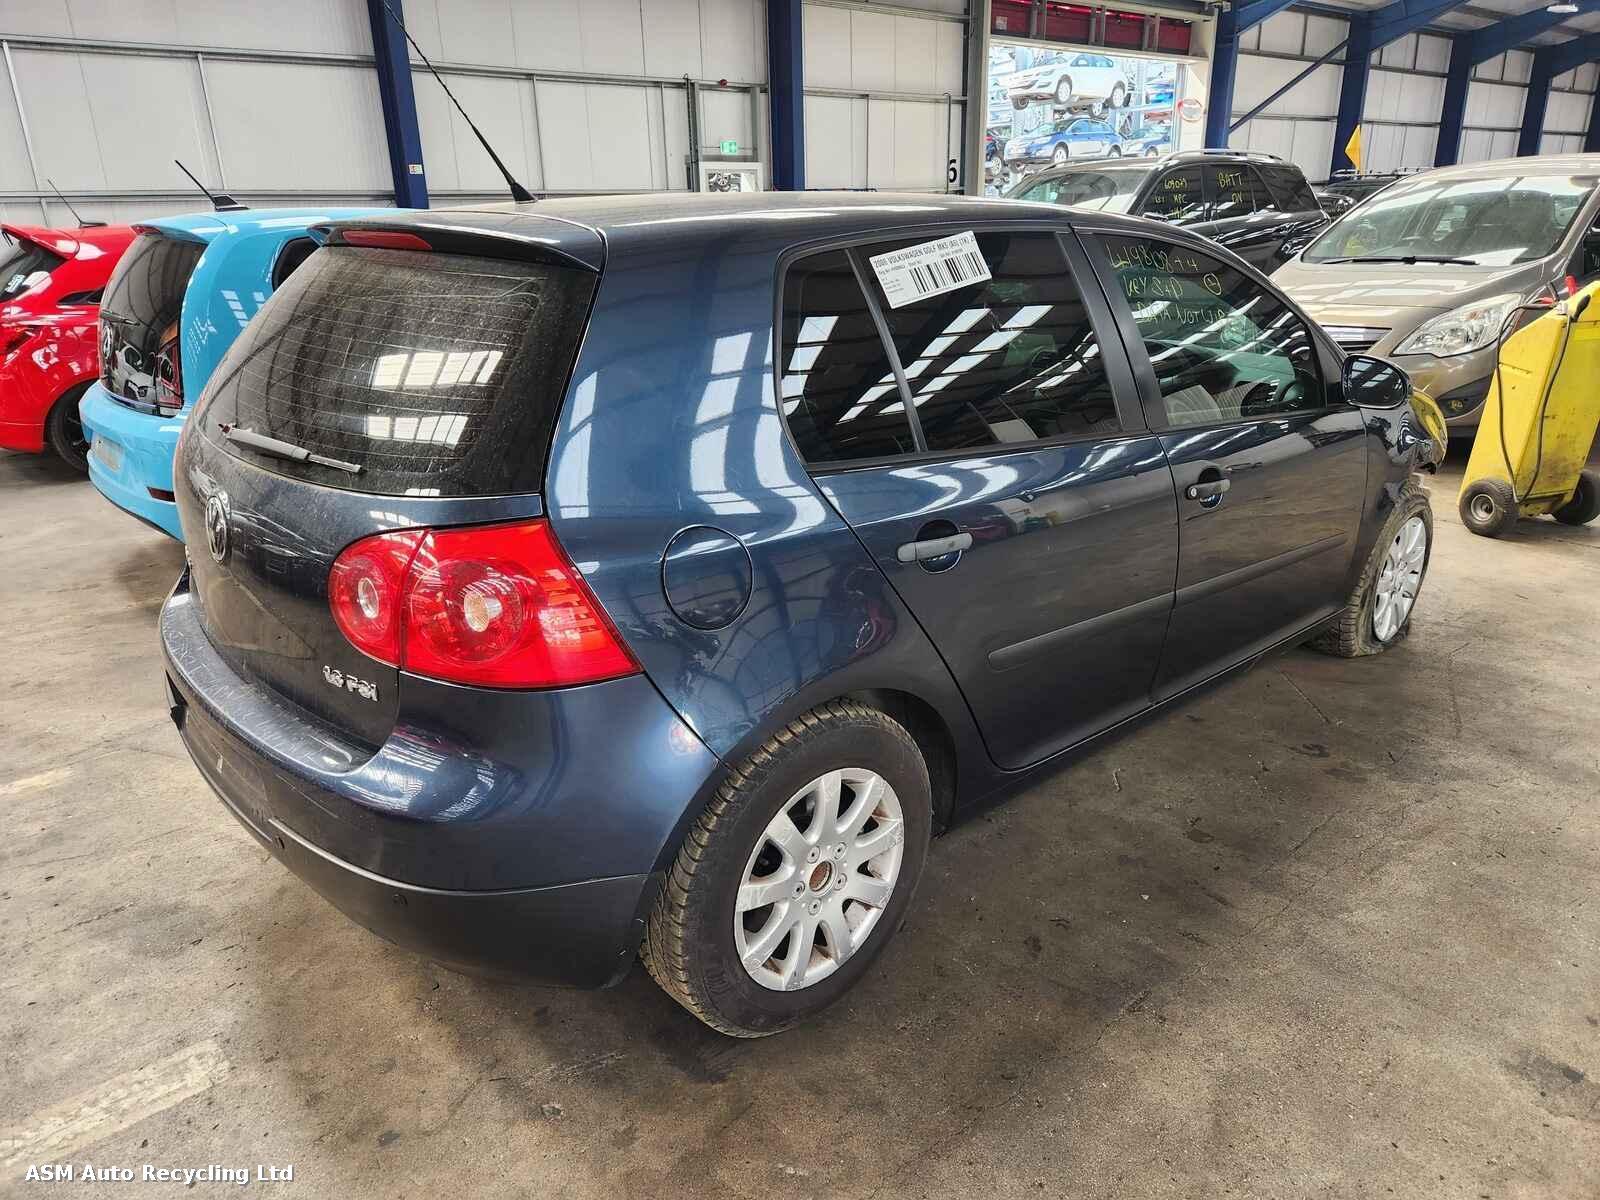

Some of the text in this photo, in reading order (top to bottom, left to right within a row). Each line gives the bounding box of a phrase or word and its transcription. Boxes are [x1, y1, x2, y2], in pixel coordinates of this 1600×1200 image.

[1219, 173, 1241, 188] BATT
[888, 249, 923, 264] VOLKSWAGEN
[923, 245, 936, 254] GOLF
